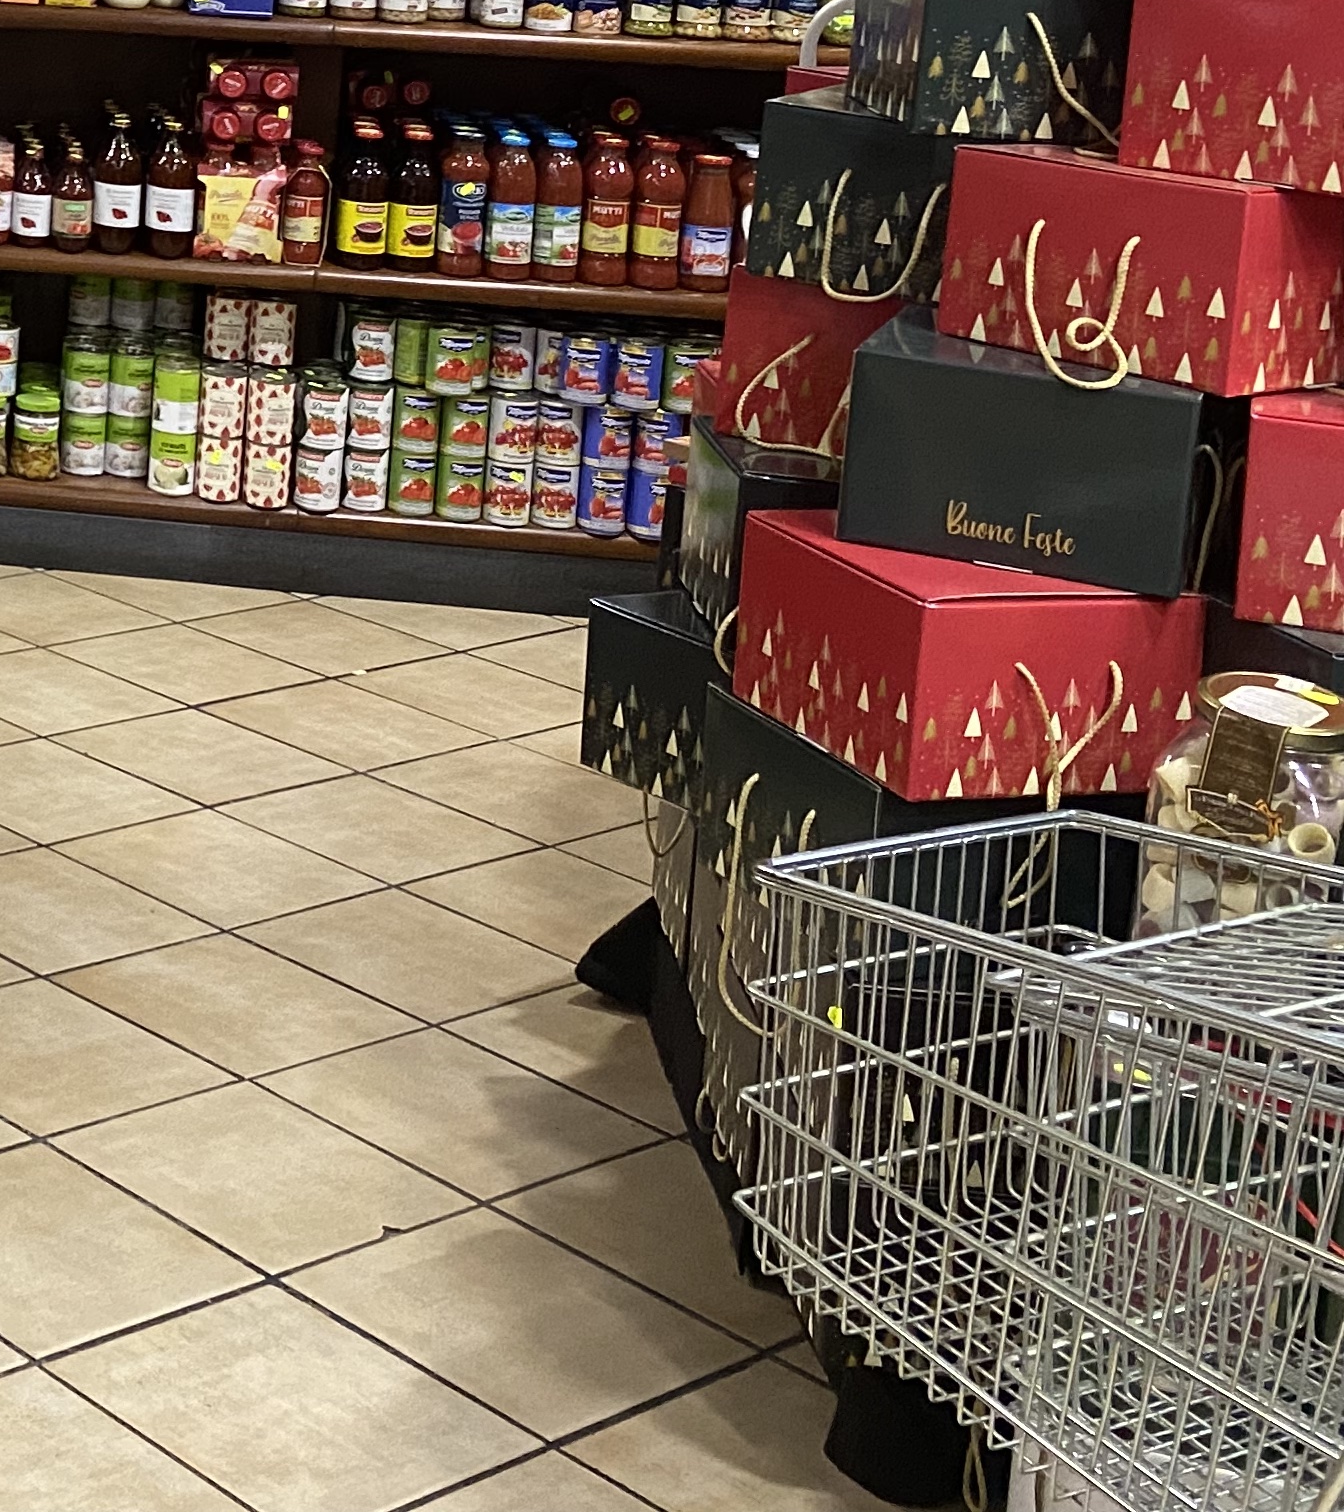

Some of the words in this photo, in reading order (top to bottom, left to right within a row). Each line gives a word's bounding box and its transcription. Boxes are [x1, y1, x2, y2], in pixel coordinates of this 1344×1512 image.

[592, 206, 623, 216] MUTTI
[946, 499, 1016, 544] Buone
[1023, 512, 1076, 557] Feste
